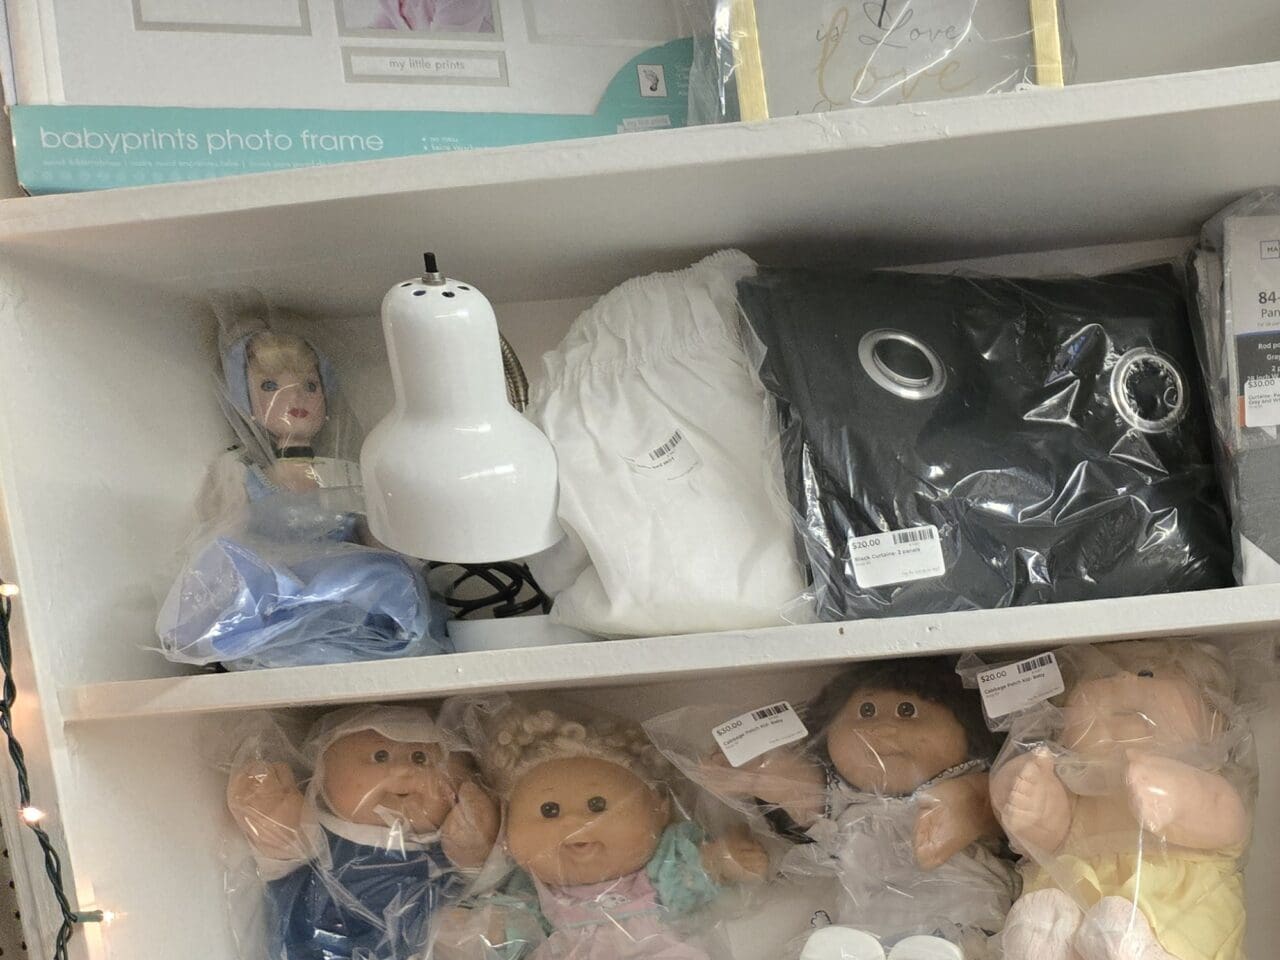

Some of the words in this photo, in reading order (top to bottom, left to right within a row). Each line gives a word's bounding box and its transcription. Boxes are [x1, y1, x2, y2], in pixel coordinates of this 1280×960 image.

[389, 58, 405, 71] my
[409, 57, 432, 70] little
[435, 58, 465, 71] prints
[40, 126, 199, 154] babyprints
[206, 128, 292, 154] photo
[300, 129, 384, 152] frame
[1258, 342, 1272, 350] Rod
[1247, 380, 1275, 388] $30.00
[852, 538, 880, 549] $20.00
[981, 670, 1007, 683] $20.00
[716, 720, 743, 736] $30.00
